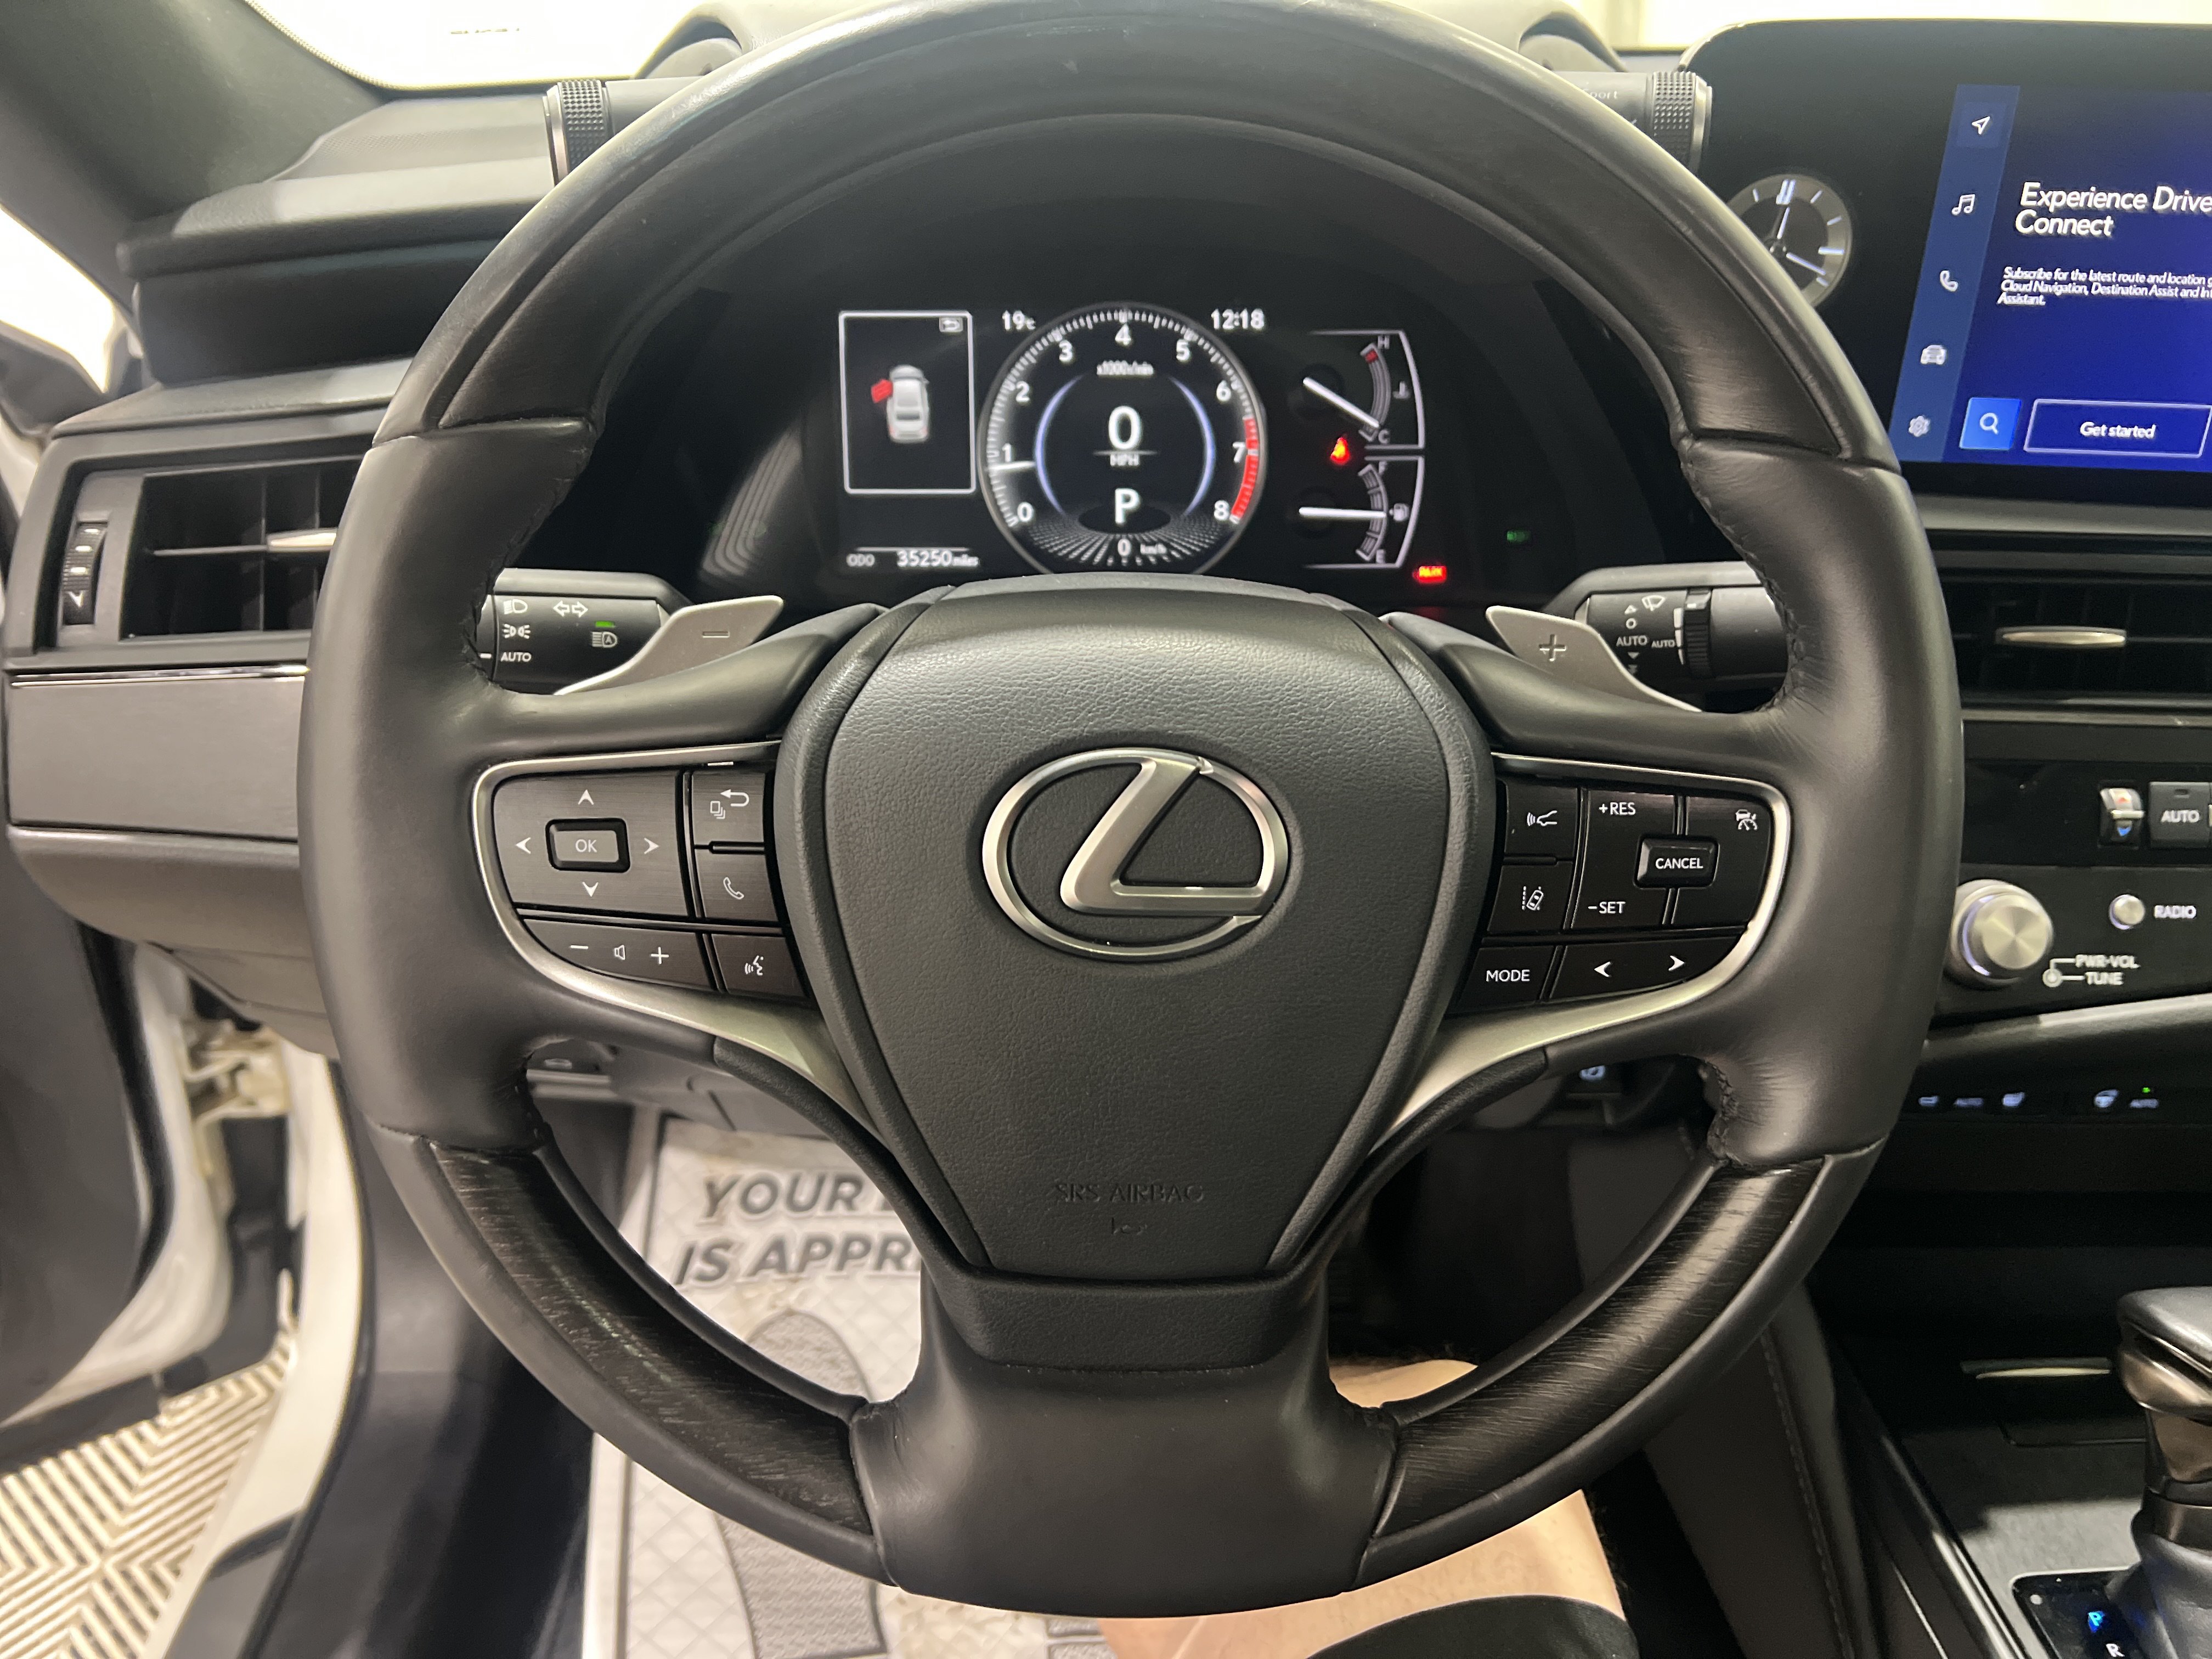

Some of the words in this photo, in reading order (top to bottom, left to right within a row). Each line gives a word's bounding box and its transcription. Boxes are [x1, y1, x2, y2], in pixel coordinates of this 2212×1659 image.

[2020, 181, 2147, 212] Experience
[2152, 185, 2212, 212] Drive
[2015, 209, 2113, 236] Connect
[2003, 267, 2053, 280] Subscribe
[2053, 268, 2069, 281] for
[2070, 269, 2087, 281] the
[2088, 269, 2117, 283] latest
[2117, 273, 2146, 283] route
[2147, 272, 2167, 284] and
[2167, 272, 2206, 285] location
[2001, 279, 2033, 292] Cloud
[2033, 280, 2089, 296] Navigation,
[2091, 282, 2148, 297] Destination
[2148, 284, 2180, 298] Assist
[2180, 286, 2200, 298] and
[1996, 292, 2047, 306] Assistant.
[1211, 308, 1265, 330] 12:18
[1115, 323, 1132, 346] 4
[1059, 340, 1074, 363] 3
[1176, 339, 1190, 363] 5
[1016, 380, 1030, 403] 2
[1216, 379, 1232, 402] 6
[1108, 405, 1142, 450] 0
[1378, 429, 1390, 444] C
[2080, 421, 2108, 437] Get
[2108, 424, 2157, 439] started
[1002, 443, 1013, 462] 1
[1232, 442, 1246, 464] 7
[1017, 501, 1034, 523] 0
[1114, 488, 1141, 524] P
[1214, 500, 1231, 521] 8
[1117, 538, 1131, 557] 0
[846, 554, 875, 567] ODO
[896, 550, 953, 567] 35250
[1616, 635, 1648, 647] AUTO
[1651, 639, 1675, 648] AUTO
[500, 651, 532, 663] AUTO
[1599, 802, 1637, 816] +RES
[2160, 809, 2201, 823] AUTO
[575, 839, 598, 853] OK
[1655, 857, 1704, 870] CANCEL
[2153, 904, 2197, 920] RADIO
[1485, 969, 1531, 983] MODE
[2085, 971, 2124, 985] TUNE
[702, 1171, 864, 1222] YOUR
[1055, 1183, 1101, 1203] SRS
[673, 1237, 738, 1285] IS
[744, 1231, 921, 1278] APPR
[2087, 1611, 2102, 1627] P
[2106, 1643, 2125, 1657] R
